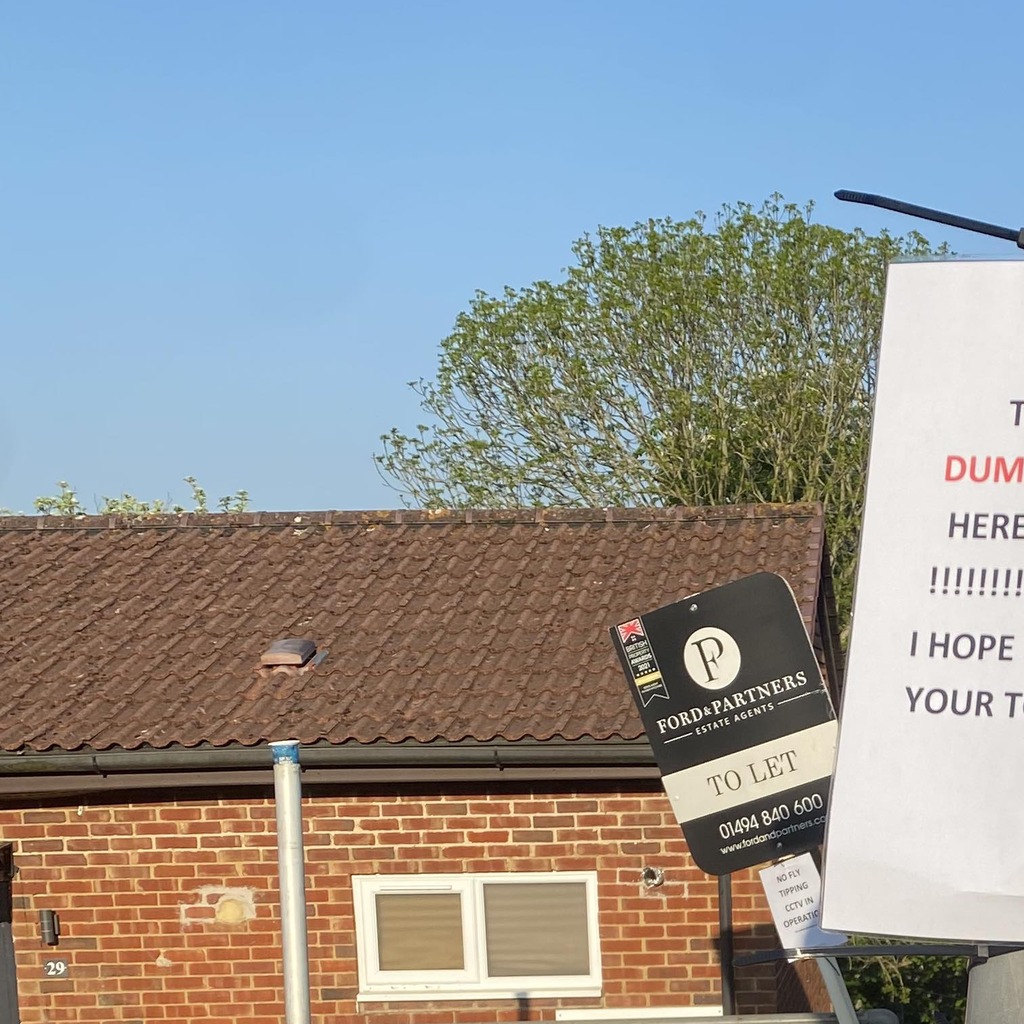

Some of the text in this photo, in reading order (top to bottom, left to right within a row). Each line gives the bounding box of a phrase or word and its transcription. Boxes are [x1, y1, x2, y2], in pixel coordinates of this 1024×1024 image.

[910, 631, 918, 657] I
[928, 631, 1015, 662] HOPE
[905, 686, 994, 718] YOUR
[695, 702, 775, 735] ESTATE AGENTS
[706, 749, 798, 797] TO LET
[719, 793, 824, 839] 01494 840 600
[776, 868, 801, 884] NO FLY
[779, 881, 809, 898] TIPPING
[785, 896, 814, 913] CCTV IN
[783, 909, 820, 929] OPERATIO
[47, 961, 65, 976] 29
